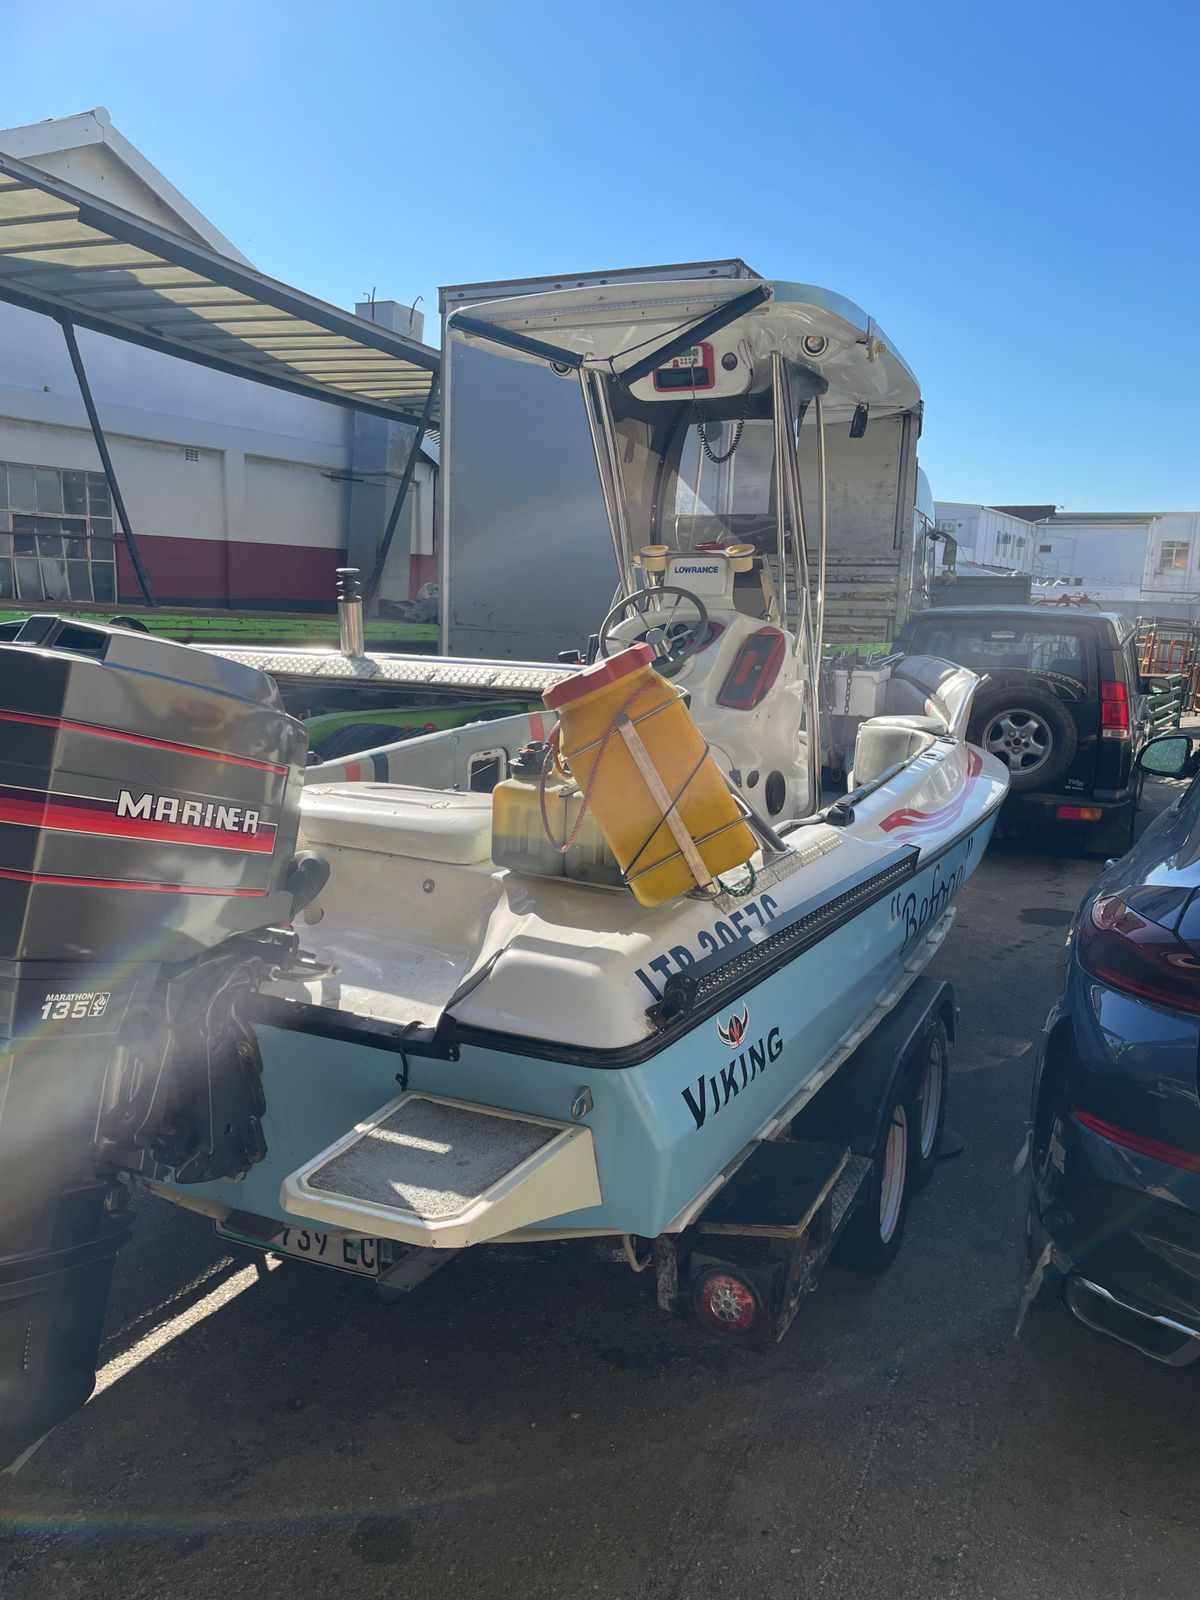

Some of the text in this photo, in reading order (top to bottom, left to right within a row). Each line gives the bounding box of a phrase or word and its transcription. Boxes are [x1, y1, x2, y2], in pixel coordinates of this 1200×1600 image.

[674, 566, 720, 574] LOWRANCE
[116, 789, 260, 834] MARINER
[45, 987, 95, 1002] MARATHON
[41, 1001, 89, 1020] 135
[680, 1026, 784, 1131] VIKING
